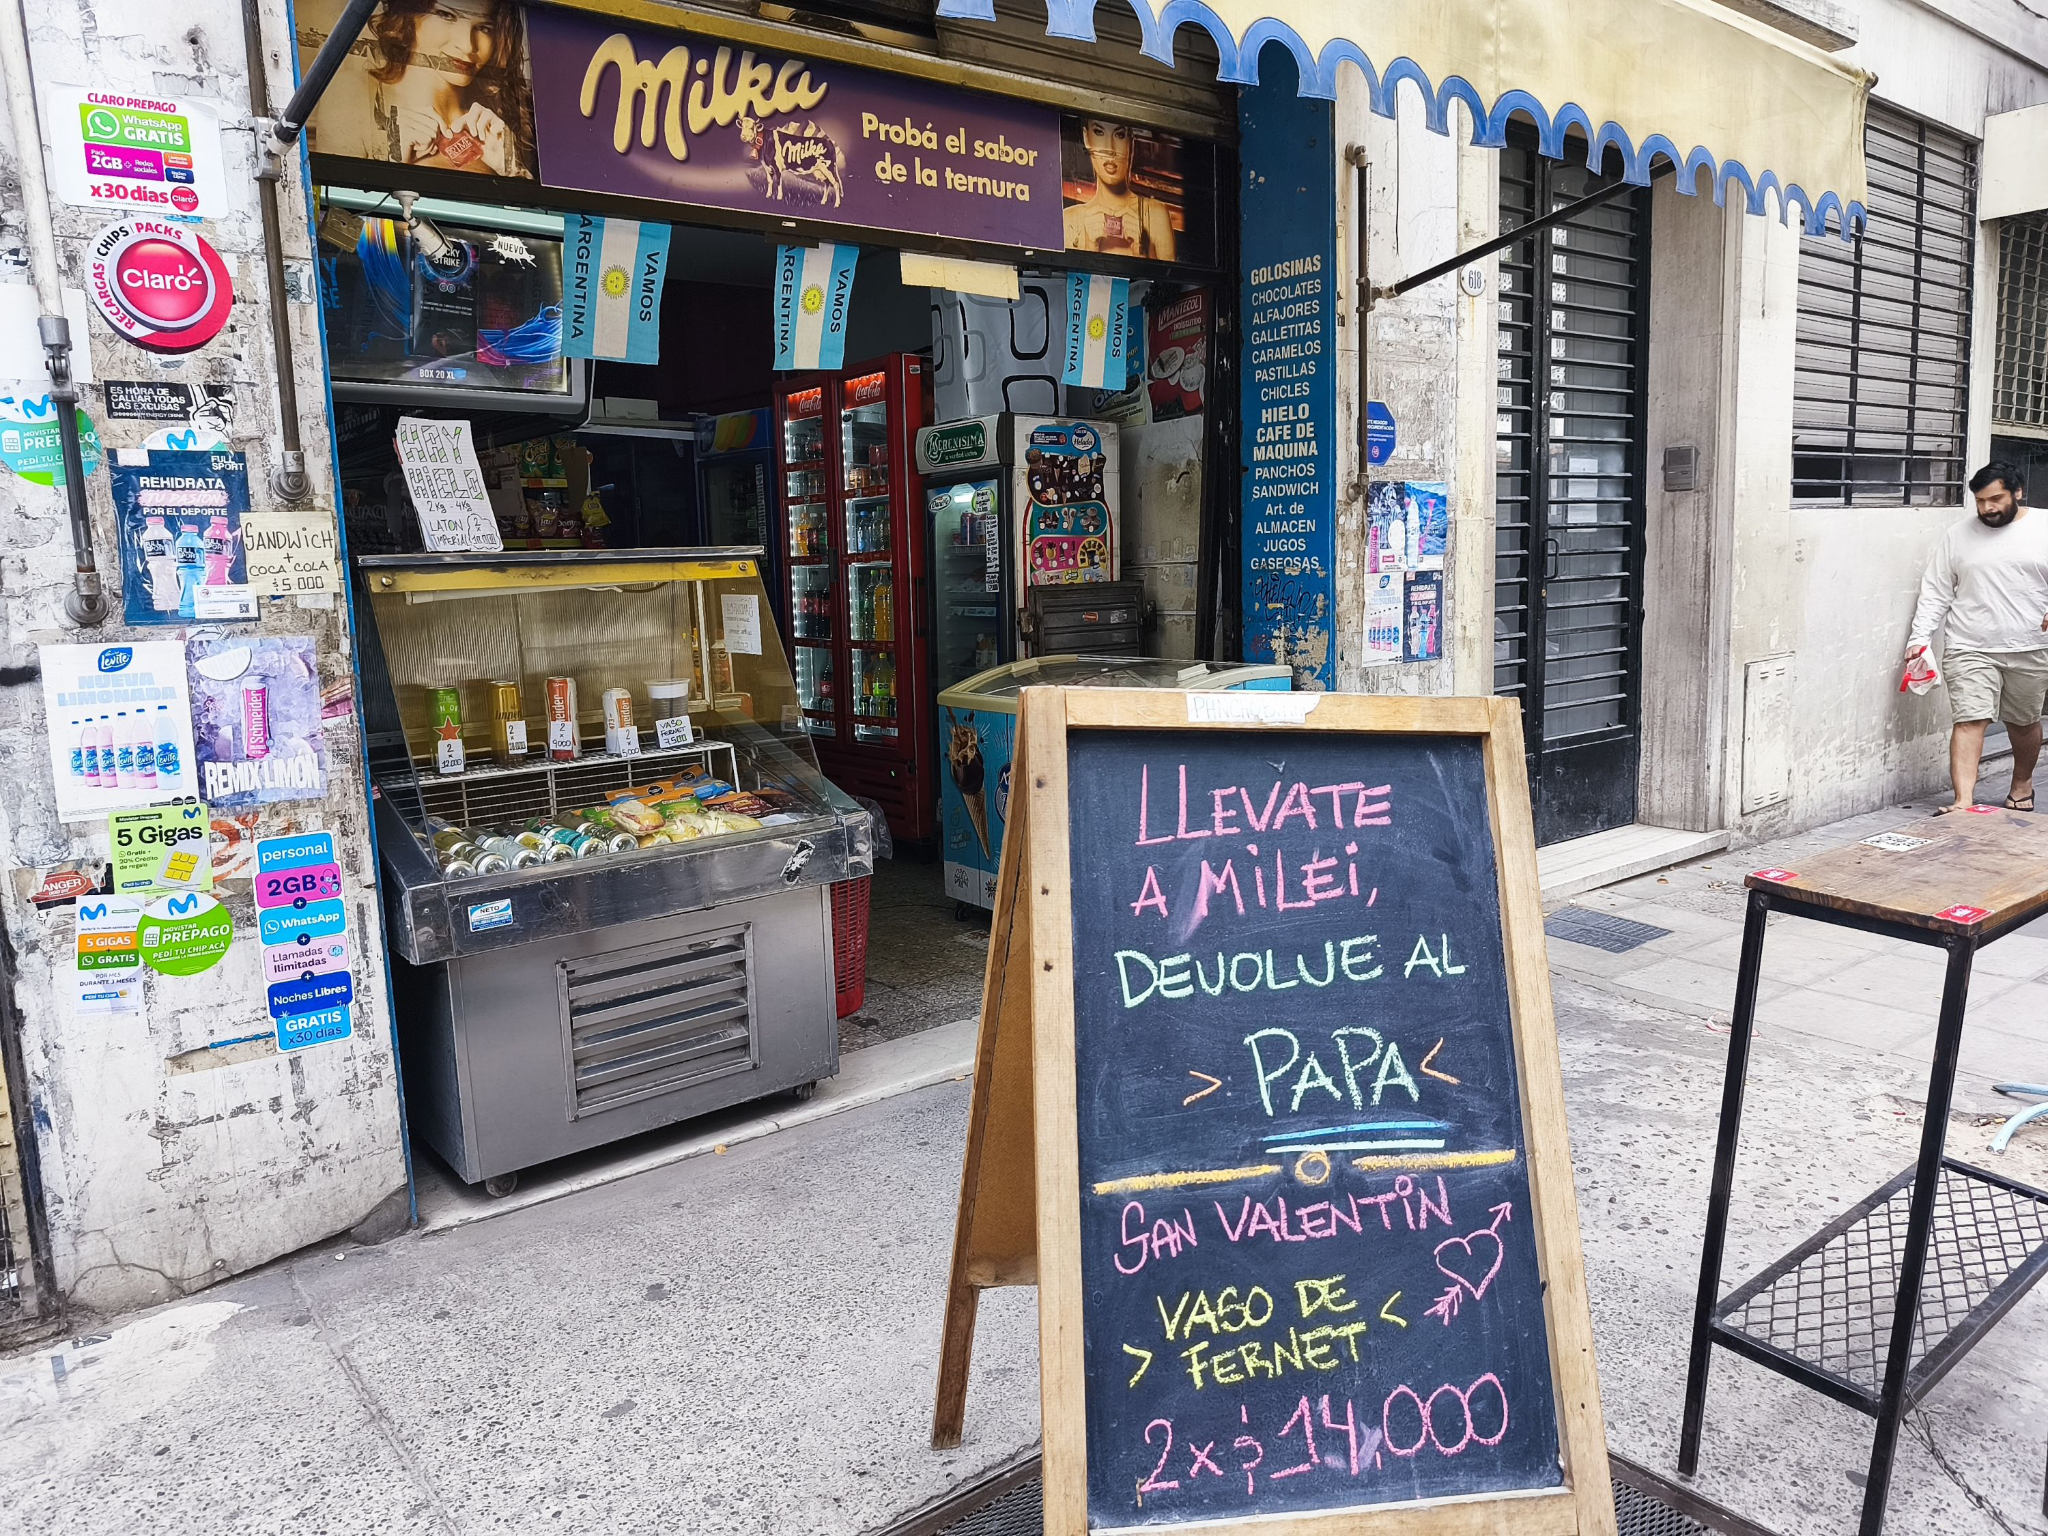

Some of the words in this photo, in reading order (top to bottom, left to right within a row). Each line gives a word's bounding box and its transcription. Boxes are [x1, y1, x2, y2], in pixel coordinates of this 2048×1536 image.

[87, 92, 125, 106] CLARO
[126, 97, 176, 113] PREPAGO
[579, 33, 828, 160] Milka
[122, 114, 182, 131] WhatsApp
[123, 127, 184, 146] GRATIS
[862, 112, 937, 150] Probá
[945, 133, 966, 157] el
[973, 138, 1039, 167] sabor
[781, 139, 828, 165] Milka
[91, 155, 123, 170] 2GB
[135, 159, 154, 168] Redes
[134, 166, 158, 174] sociales
[874, 153, 908, 184] de
[914, 163, 938, 188] la
[944, 168, 1031, 202] ternura
[90, 183, 128, 200] x30
[130, 185, 169, 204] días
[172, 194, 196, 203] Claro
[96, 225, 130, 257] CHIPS
[135, 222, 183, 240] PACKS
[497, 240, 525, 255] NUEVO
[122, 266, 196, 291] Claro
[570, 213, 593, 340] ARGENTINA
[1251, 254, 1322, 286] GOLOSINAS
[1468, 270, 1482, 289] 618
[93, 262, 136, 330] RECARGAS
[639, 251, 661, 323] VAMOS
[1252, 278, 1322, 306] CHOCOLATES
[778, 244, 797, 356] ARGENTINA
[830, 267, 850, 333] VAMOS
[1160, 297, 1199, 325] MANTECOL
[1252, 299, 1320, 326] ALFAJORES
[1067, 276, 1084, 373] ARGENTINA
[1111, 302, 1125, 358] VAMOS
[1252, 319, 1321, 345] GALLETITAS
[1252, 340, 1322, 364] CARAMELOS
[419, 369, 434, 379] BOX
[436, 370, 445, 379] 20
[446, 371, 456, 379] XL
[1255, 361, 1316, 383] PASTILLAS
[110, 386, 123, 395] ES
[125, 387, 156, 396] HORA
[157, 388, 170, 396] DE
[111, 394, 151, 403] CALLAR
[152, 395, 186, 405] TODAS
[855, 380, 881, 401] Coca-Cola
[1261, 381, 1310, 401] CHICLES
[112, 402, 132, 410] LAS
[133, 403, 180, 412] EXCUSAS
[1261, 403, 1310, 424] HIELO
[23, 428, 60, 437] MOVISTAR
[23, 431, 95, 451] PREPGO
[1256, 424, 1291, 443] CAFE
[1296, 422, 1315, 439] DE
[400, 424, 462, 464] HAY
[1253, 441, 1318, 462] MAQUINA
[17, 455, 39, 466] PEDÍ
[41, 455, 53, 463] TU
[211, 455, 236, 464] FULL
[211, 461, 244, 471] SPORT
[1255, 463, 1316, 480] PANCHOS
[139, 477, 225, 490] REHIDRATA
[1252, 482, 1319, 499] SANDWICH
[143, 508, 165, 516] POR
[166, 508, 179, 516] EL
[181, 508, 228, 516] DEPORTE
[1265, 504, 1286, 515] Art.
[1289, 502, 1305, 514] de
[429, 519, 464, 532] LATON
[474, 517, 481, 527] 2
[1255, 519, 1316, 534] ALMACEN
[1263, 538, 1306, 552] JUGOS
[1250, 556, 1320, 570] GASEOSAS
[78, 672, 155, 689] NUEVA
[57, 686, 177, 707] LIMONADA
[249, 690, 265, 745] Schneider
[560, 723, 566, 731] 2
[660, 719, 683, 729] VASO
[508, 725, 514, 734] 2
[625, 729, 631, 740] 2
[660, 726, 686, 737] FERNET
[446, 743, 454, 753] 2
[204, 761, 262, 800] REMIX
[1135, 763, 1393, 845] LLEVATE
[117, 828, 133, 846] 5
[138, 825, 203, 846] Gigas
[262, 841, 328, 864] personal
[267, 875, 317, 897] 2GB
[1130, 865, 1168, 917] A
[480, 905, 500, 914] NETO
[163, 923, 197, 933] MOVISTAR
[281, 913, 340, 929] WhatsApp
[86, 938, 94, 947] 5
[96, 936, 132, 946] GIGAS
[162, 924, 230, 945] PREPAGO
[97, 955, 136, 964] GRATIS
[152, 948, 173, 959] PEDÍ
[175, 948, 186, 956] TU
[187, 945, 207, 954] CHIP
[209, 940, 225, 951] ACÁ
[272, 947, 323, 963] Llamadas
[1404, 933, 1467, 979] AL
[273, 957, 327, 974] Ilimitadas
[273, 992, 314, 1006] Noches
[314, 985, 348, 998] Libres
[285, 1011, 342, 1032] GRATIS
[288, 1031, 313, 1045] x30
[315, 1026, 343, 1040] días
[1243, 1026, 1420, 1117] PAPA
[1114, 1201, 1198, 1275] SAN
[1157, 1285, 1274, 1342] VASO
[1295, 1273, 1358, 1318] DE
[1181, 1322, 1366, 1390] FERNET
